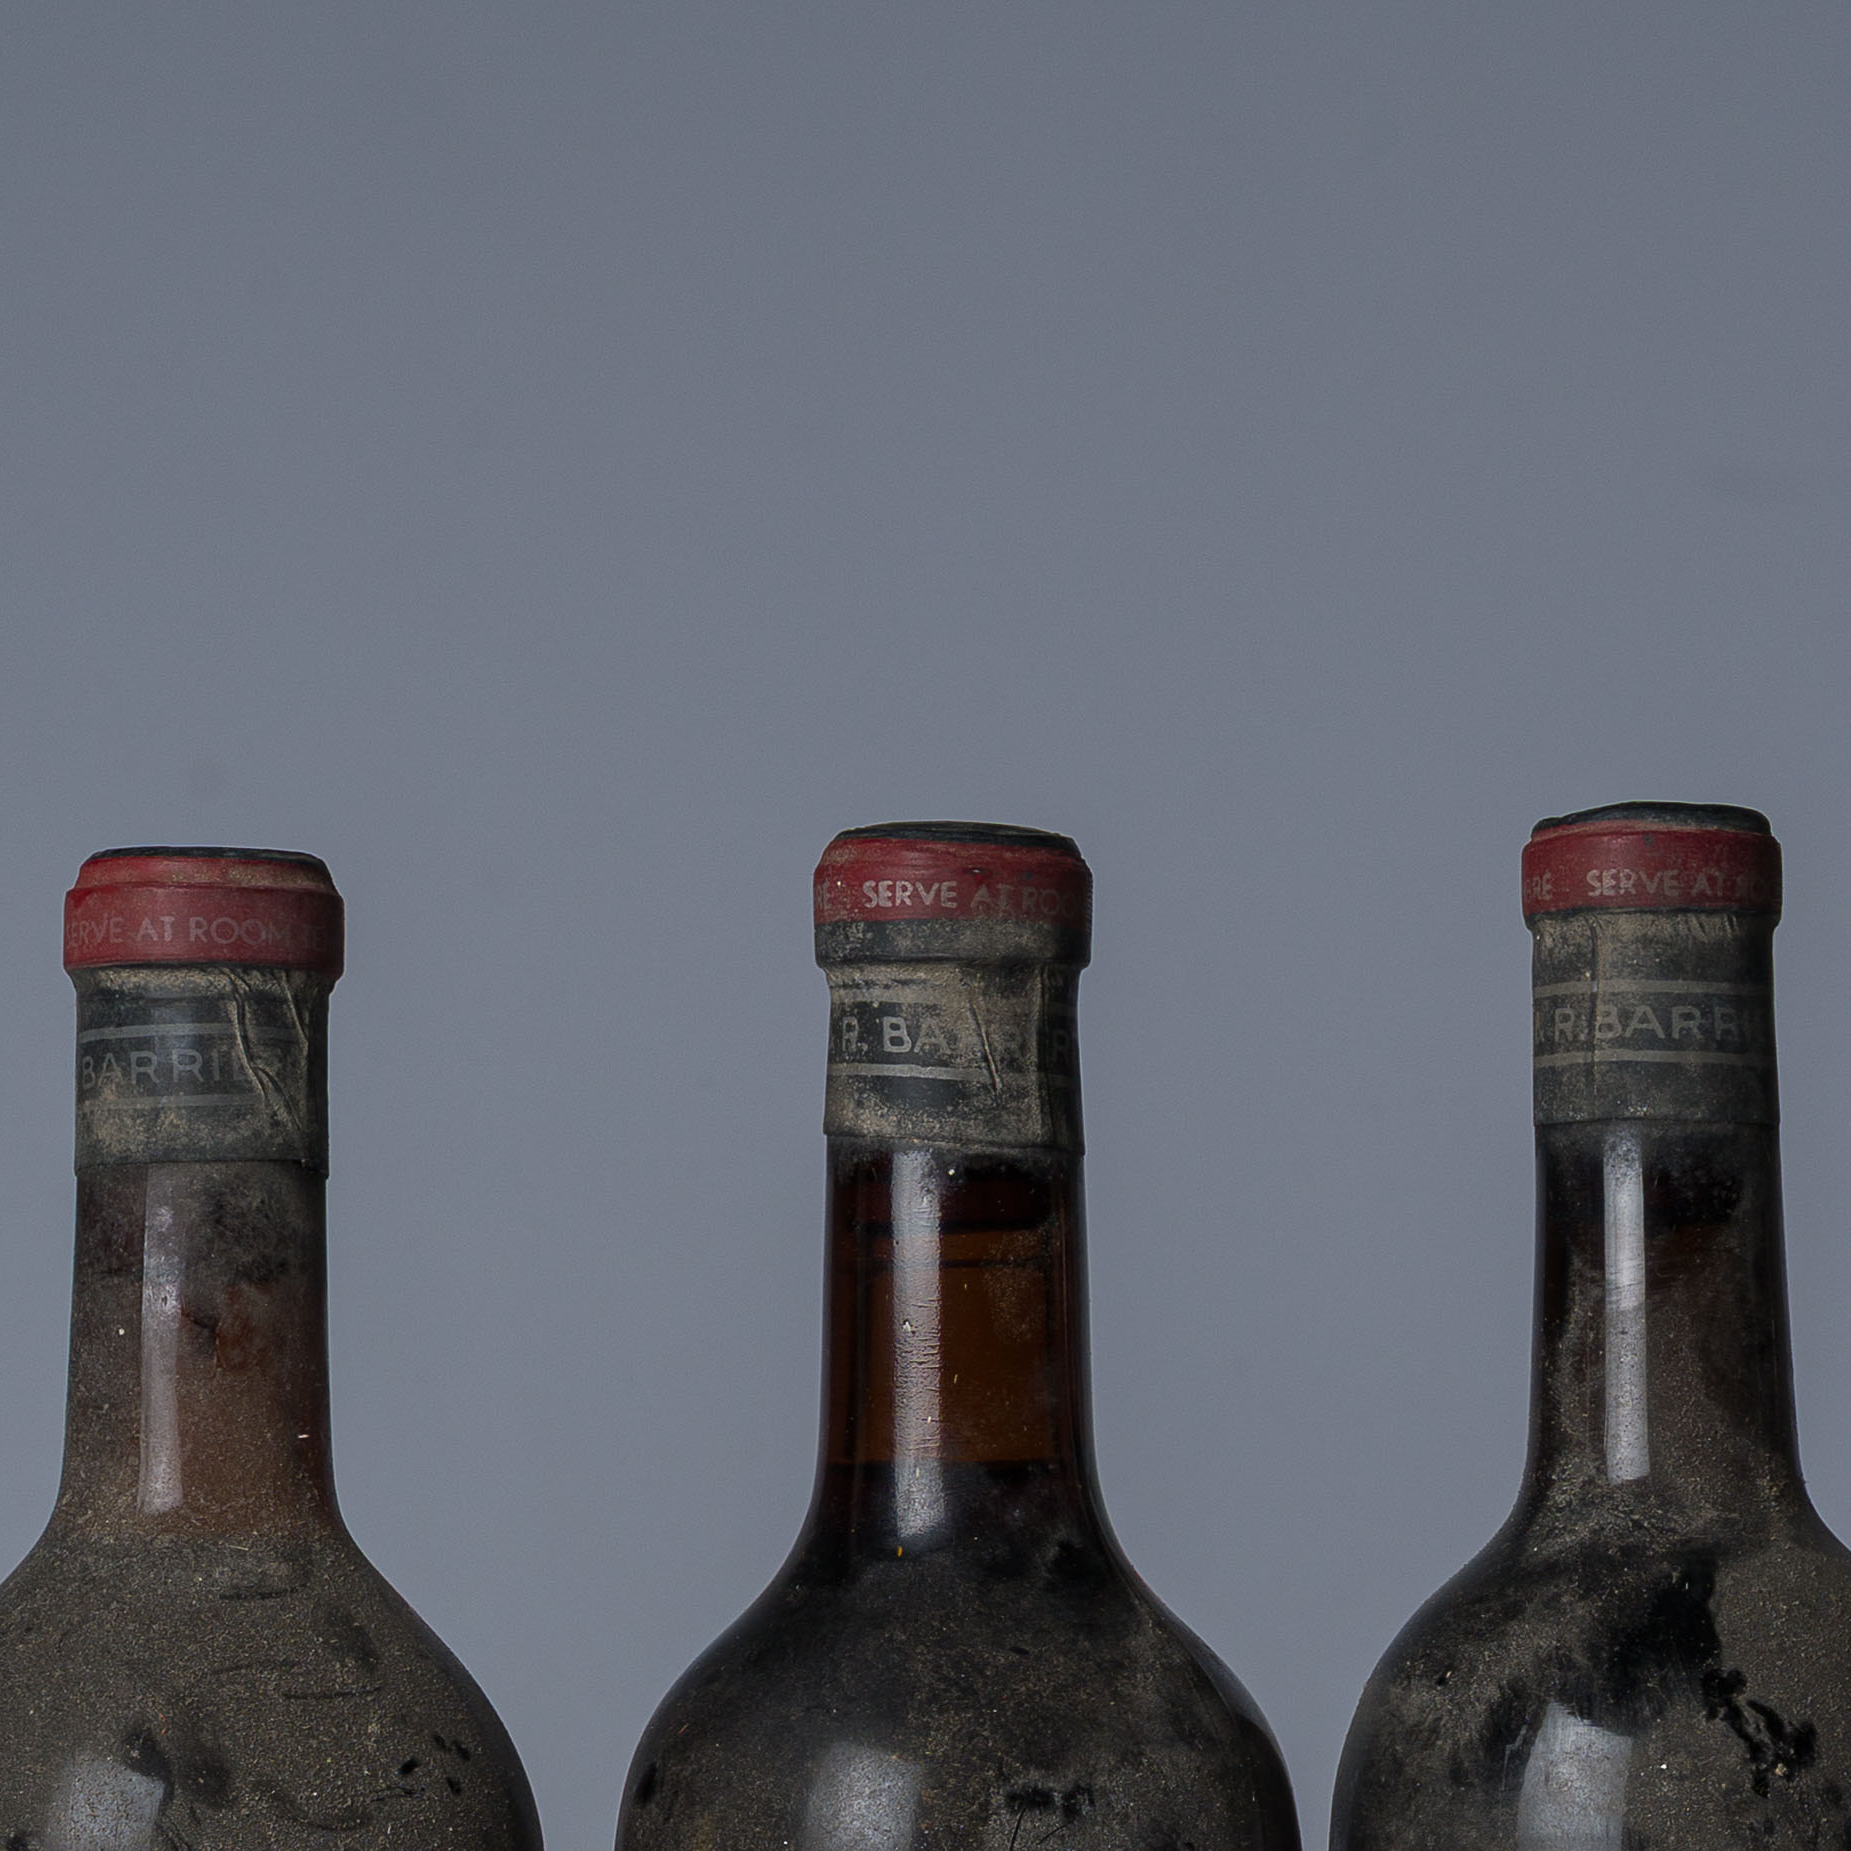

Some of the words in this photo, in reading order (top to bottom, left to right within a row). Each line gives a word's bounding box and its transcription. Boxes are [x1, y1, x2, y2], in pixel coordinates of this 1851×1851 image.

[862, 880, 958, 908] SERVE
[971, 883, 1015, 909] AT
[1586, 869, 1680, 897] SERVE
[136, 916, 176, 941] AT
